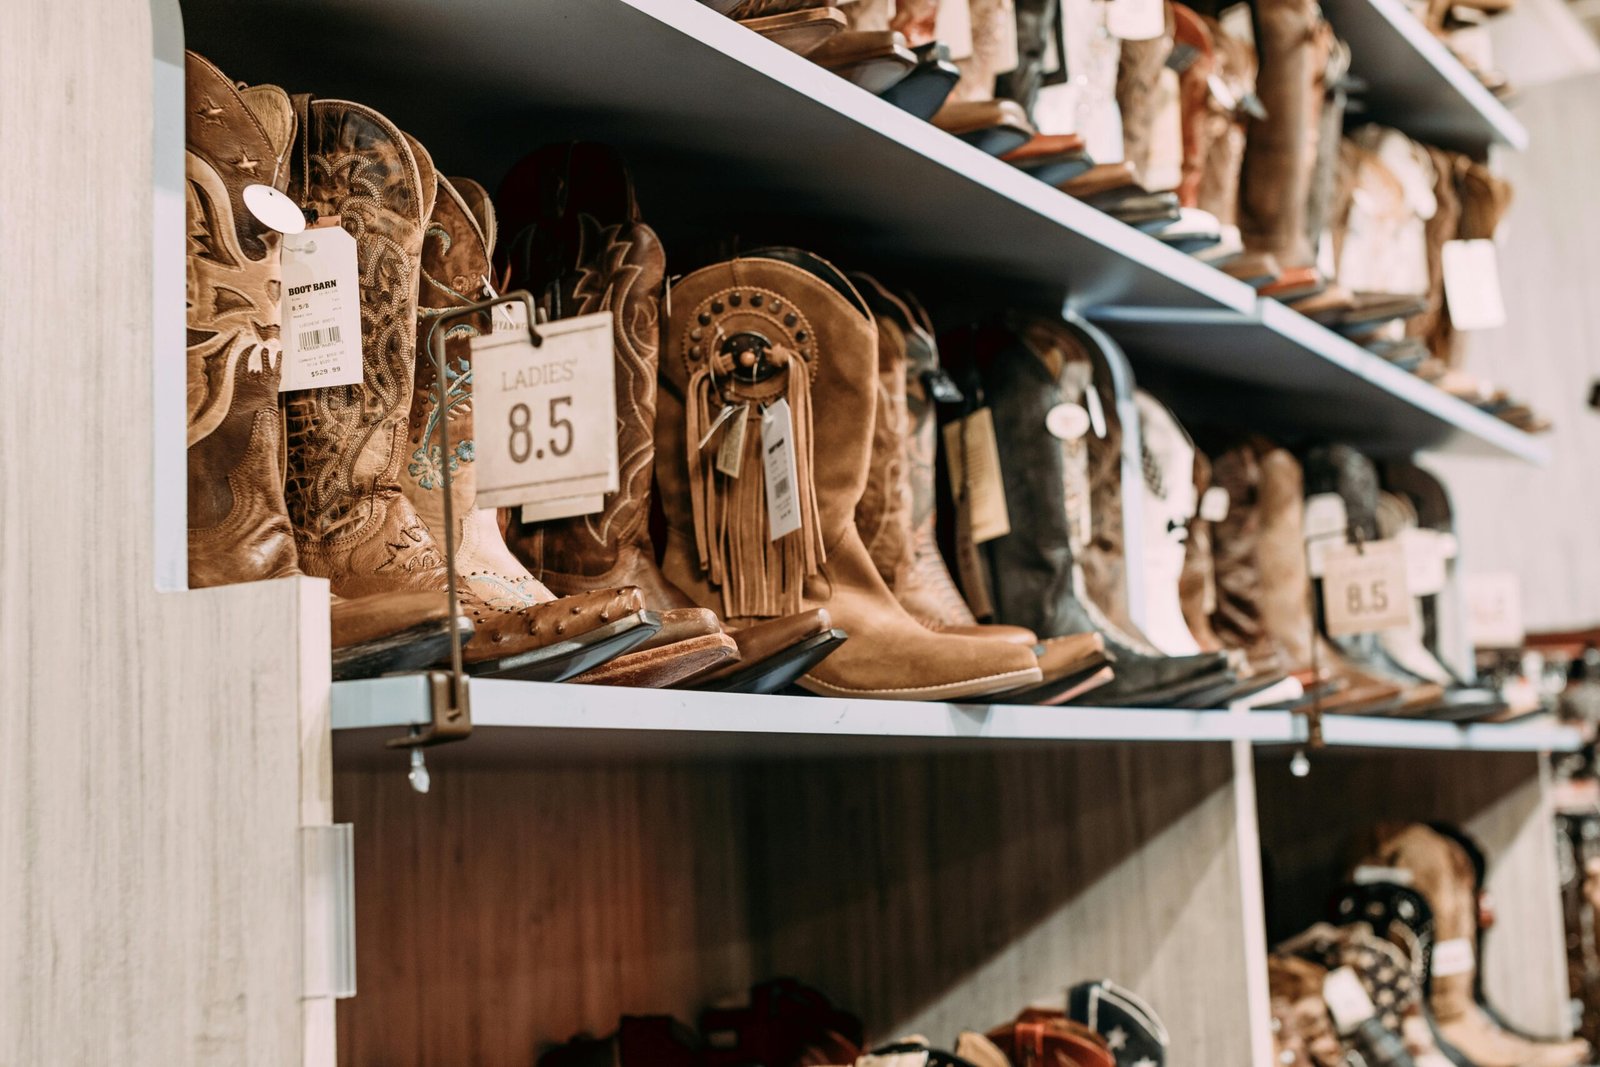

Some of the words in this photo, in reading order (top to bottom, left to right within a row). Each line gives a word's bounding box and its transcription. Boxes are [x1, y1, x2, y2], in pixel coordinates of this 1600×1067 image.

[288, 285, 311, 296] BOOT
[313, 280, 336, 291] BARN
[310, 366, 341, 377] $52999
[501, 359, 578, 392] LADIES'
[508, 396, 572, 464] 8.5
[1347, 581, 1388, 615] 8.5
